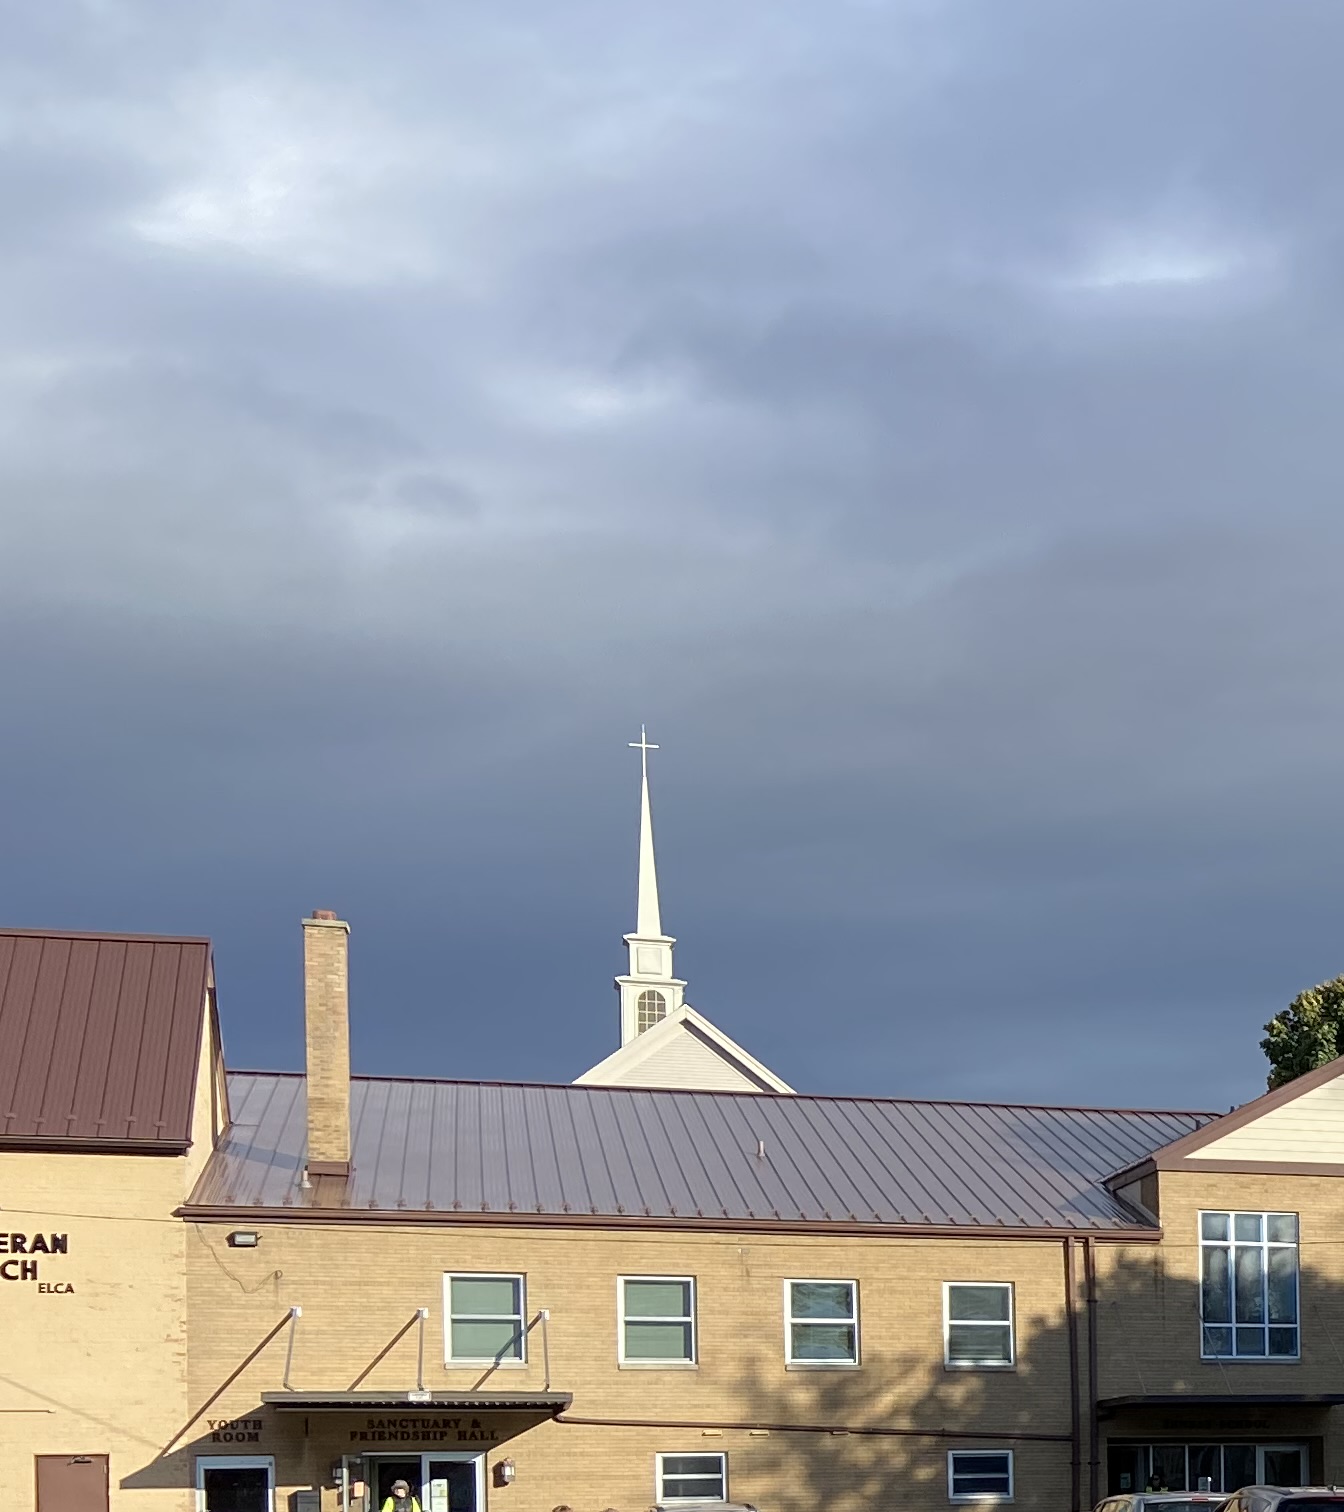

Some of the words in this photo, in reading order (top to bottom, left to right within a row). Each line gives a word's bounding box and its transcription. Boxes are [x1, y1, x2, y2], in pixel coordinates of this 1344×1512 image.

[38, 1282, 75, 1294] ELCA
[207, 1419, 263, 1430] YOUTH
[367, 1418, 462, 1429] SANCTUARY
[471, 1418, 482, 1429] &
[212, 1431, 260, 1443] ROOM
[350, 1430, 448, 1441] FRIENDSHIP
[457, 1430, 499, 1441] HALL
